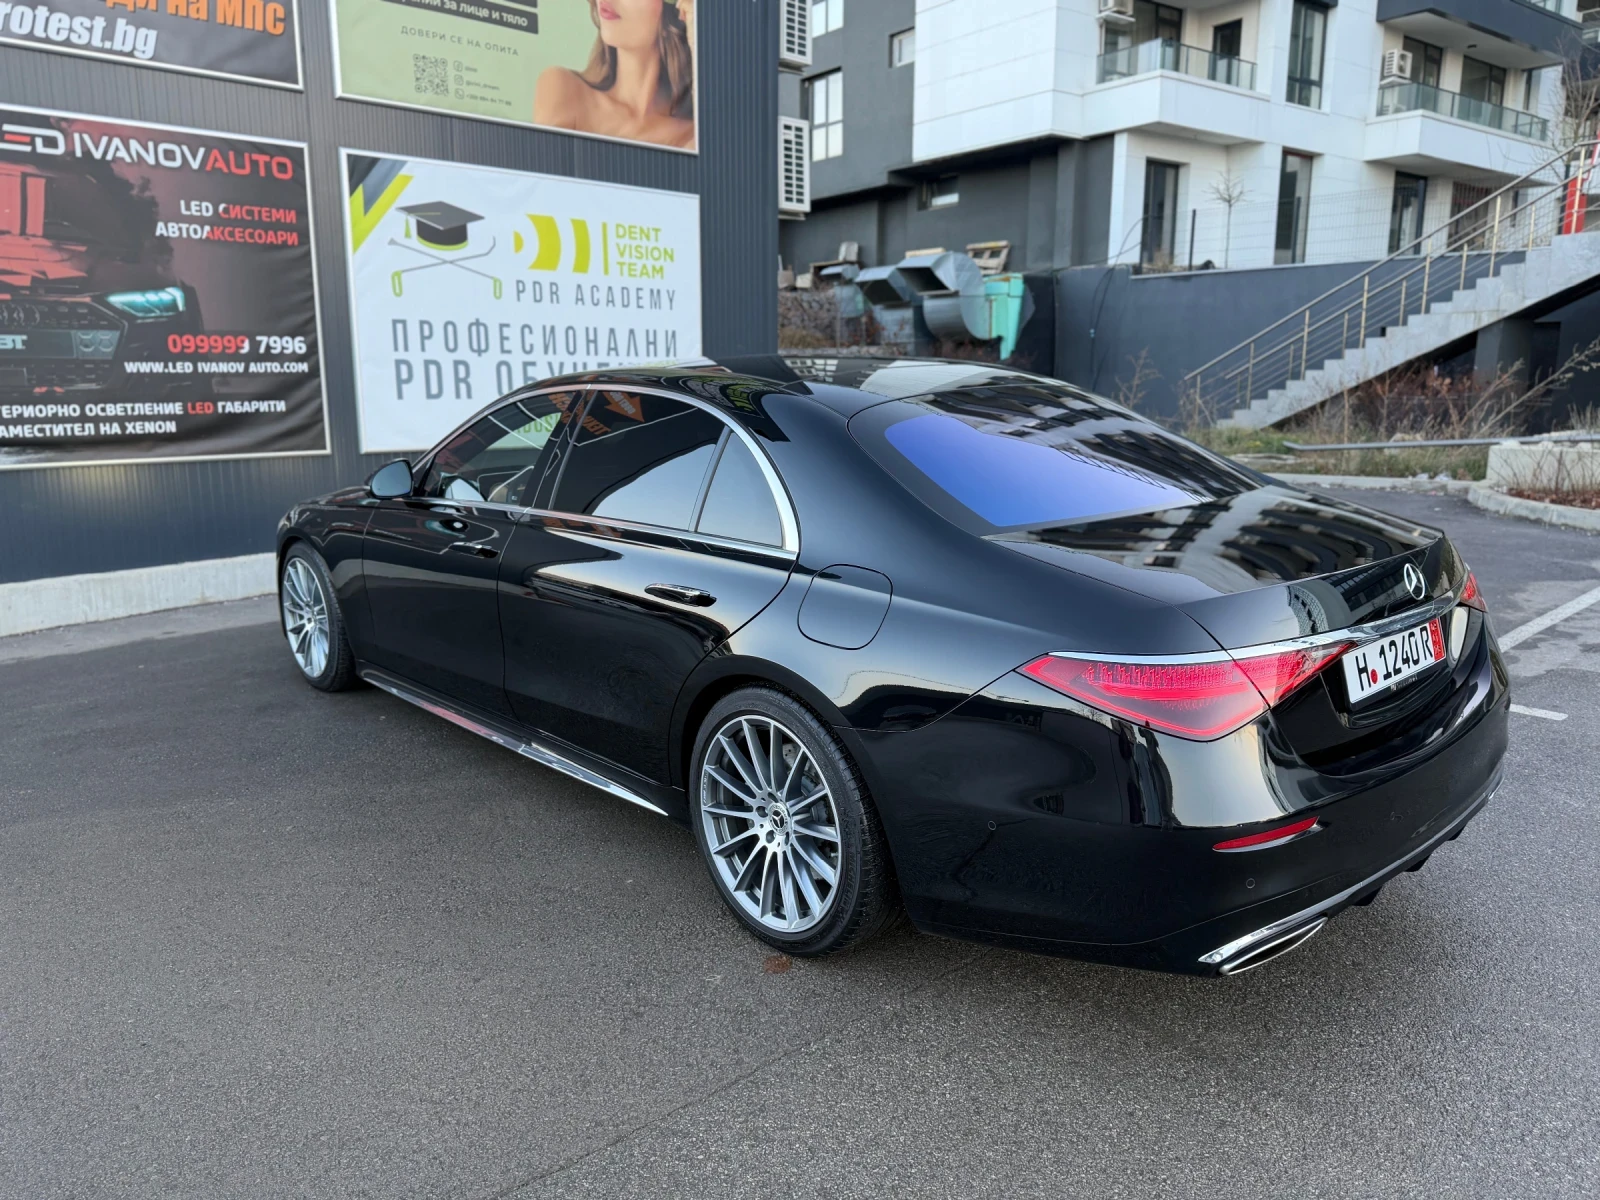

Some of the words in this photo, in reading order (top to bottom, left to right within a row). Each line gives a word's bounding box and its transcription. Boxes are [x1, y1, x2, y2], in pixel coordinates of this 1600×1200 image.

[459, 3, 490, 18] лице
[491, 10, 500, 20] и
[501, 12, 528, 27] тяло
[400, 25, 446, 41] ДОВЕРИ
[450, 35, 463, 45] СЕ
[467, 38, 481, 48] НА
[484, 42, 519, 56] ОПИТА
[180, 199, 214, 217] LED
[218, 203, 297, 224] СИСТЕМИ
[155, 220, 299, 247] АВТОАКСЕСОАРИ
[614, 223, 661, 242] DENT
[615, 243, 675, 263] VISION
[616, 261, 665, 280] TEAM
[515, 279, 561, 305] PDR
[575, 283, 677, 312] ACADEMY
[167, 333, 250, 354] 099999
[255, 335, 307, 354] 7996
[391, 318, 678, 359] ПРОФЕСИОНАЛНИ
[124, 361, 194, 374] WWW.LED
[197, 361, 245, 373] IVANOV
[248, 361, 309, 373] AUTO.COM
[394, 358, 473, 401] PDR
[0, 403, 81, 419] ЕРИОРНО
[85, 401, 184, 417] ОСВЕТЛЕНИЕ
[187, 402, 214, 415] LED
[217, 400, 287, 414] ГАБАРИТИ
[100, 422, 122, 435] НА
[125, 420, 177, 435] XENON
